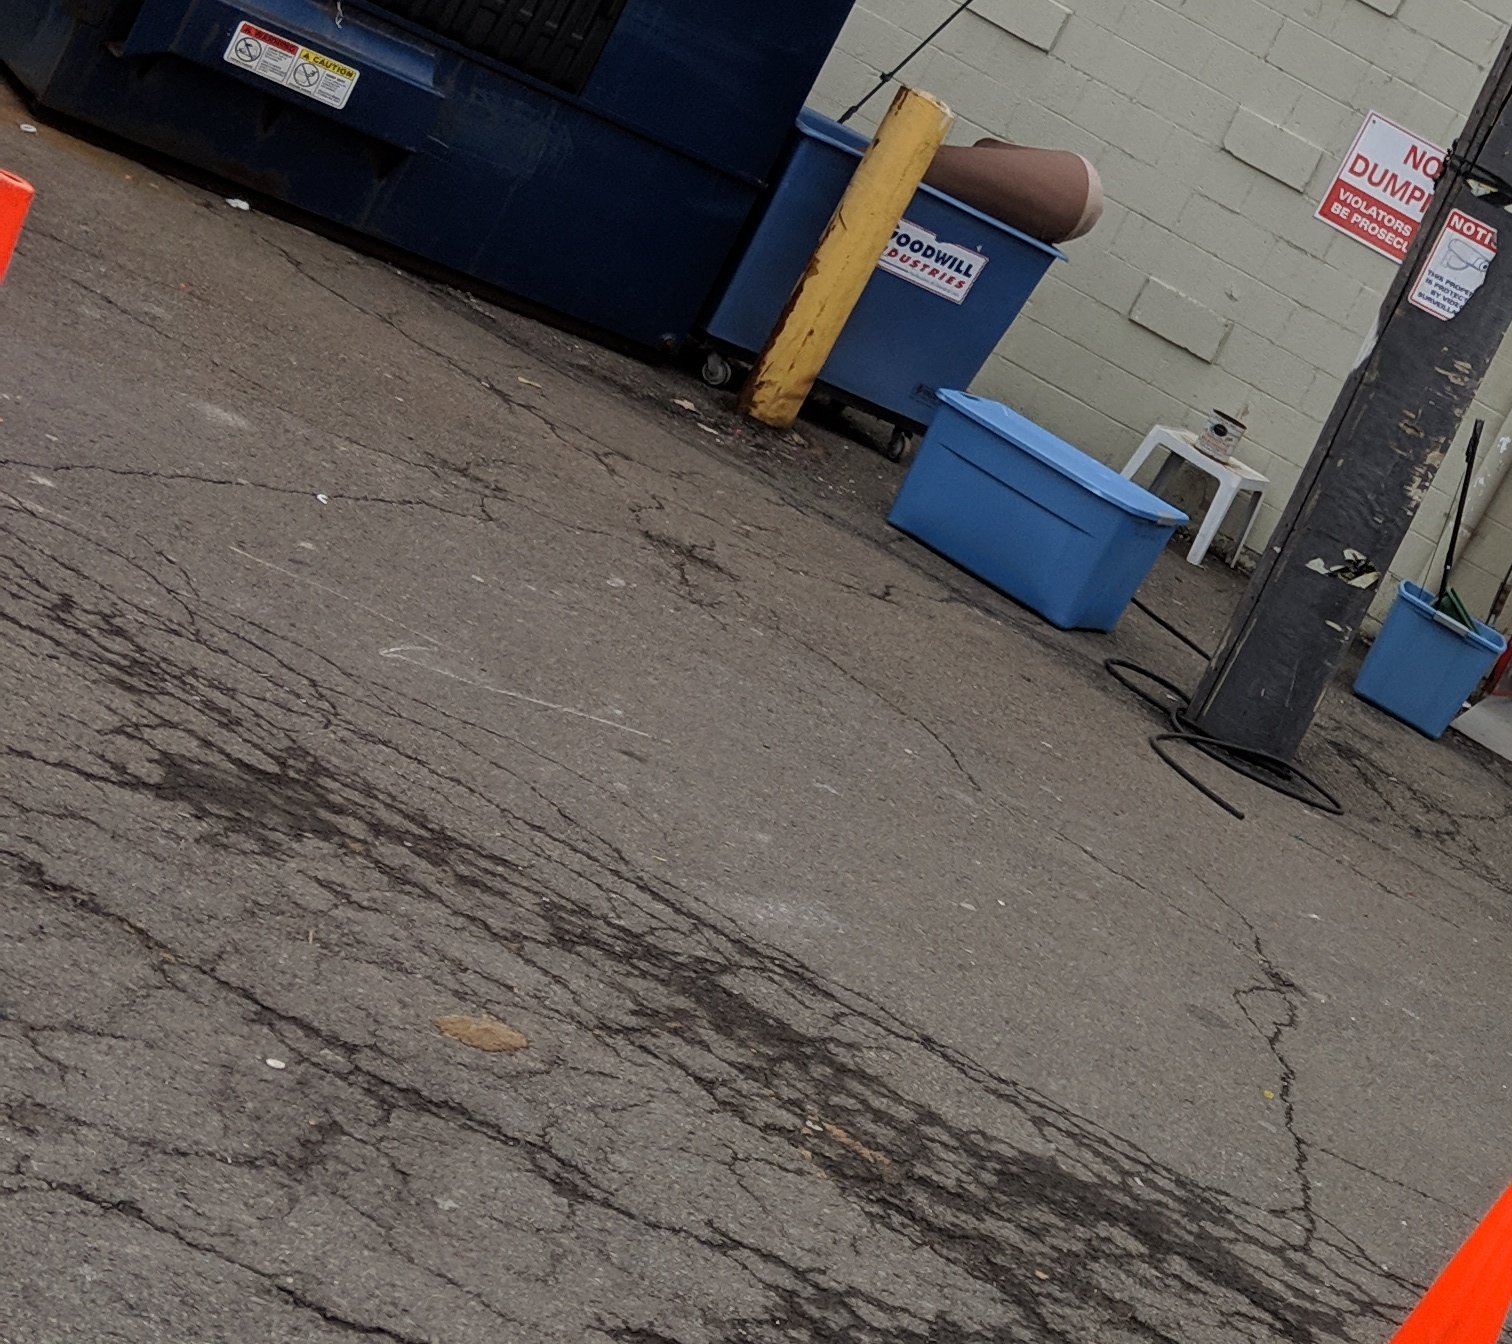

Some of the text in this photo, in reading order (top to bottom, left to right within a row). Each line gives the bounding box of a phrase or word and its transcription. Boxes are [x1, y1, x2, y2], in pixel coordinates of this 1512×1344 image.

[312, 56, 355, 79] CAUTION
[1404, 144, 1443, 179] NO
[1330, 201, 1349, 219] BE
[1339, 187, 1413, 237] VIOLATORS
[884, 246, 966, 289] DUSTRIES
[1428, 269, 1444, 282] THIS
[1425, 278, 1433, 286] IS
[1431, 289, 1441, 299] BY
